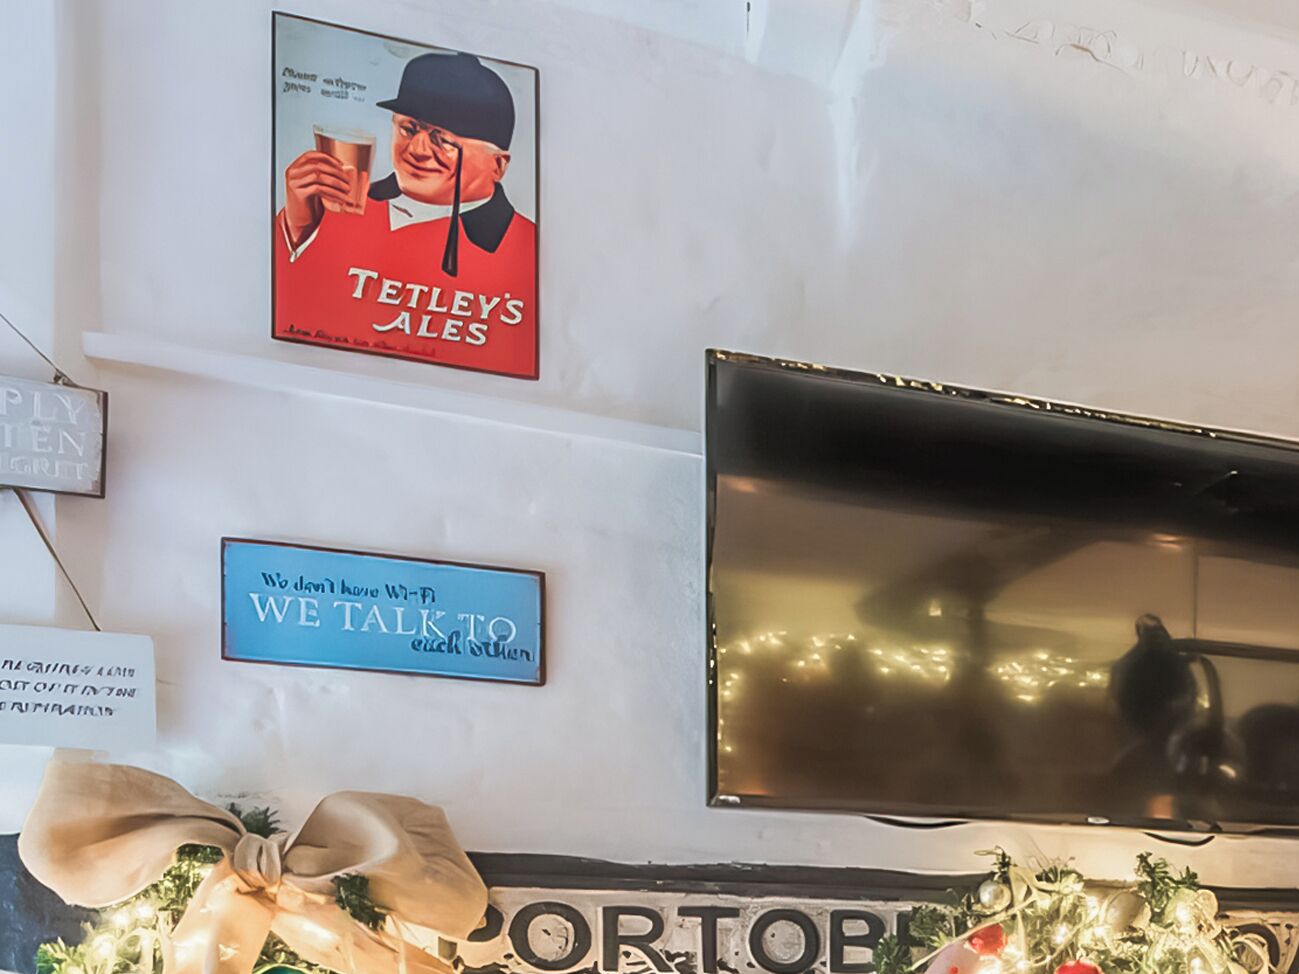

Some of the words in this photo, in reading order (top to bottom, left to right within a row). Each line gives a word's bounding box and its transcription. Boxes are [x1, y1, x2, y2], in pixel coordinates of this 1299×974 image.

[348, 267, 525, 326] TETLEY'S
[372, 311, 489, 346] ALES
[249, 592, 321, 628] WE
[333, 600, 446, 639] TALK
[457, 612, 517, 645] TO
